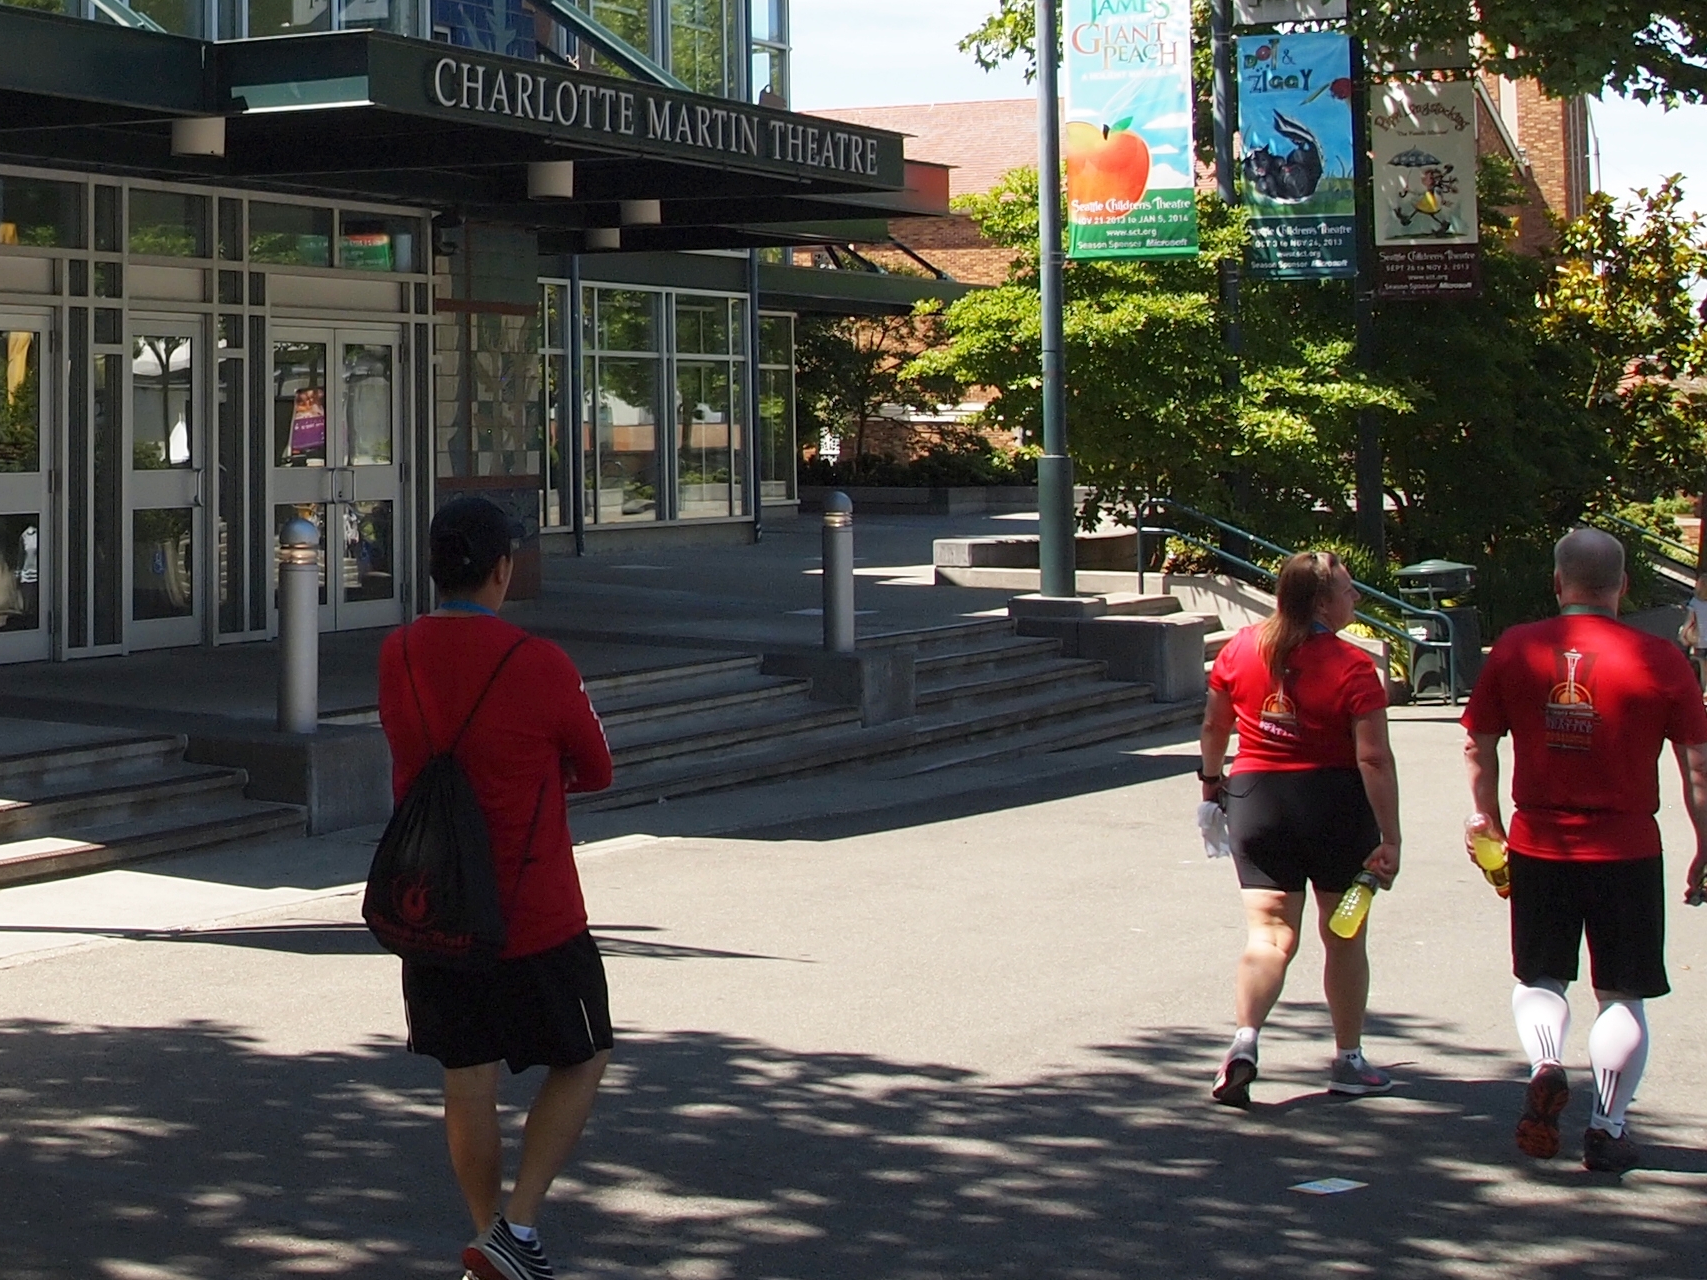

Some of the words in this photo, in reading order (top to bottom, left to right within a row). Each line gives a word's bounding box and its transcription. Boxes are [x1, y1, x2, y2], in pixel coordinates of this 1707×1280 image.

[1071, 22, 1166, 54] GIANT
[1103, 42, 1177, 70] PEACH
[434, 58, 635, 135] CHARLOTTE
[647, 97, 759, 156] MARTIN
[770, 120, 878, 175] THEATRE
[1071, 199, 1103, 213] Seattle
[1152, 196, 1191, 209] Theatre
[1106, 228, 1156, 236] www.sct.org
[1317, 222, 1352, 235] Theatre
[1077, 241, 1107, 249] Season
[1109, 241, 1142, 249] Sponsor
[1146, 239, 1187, 247] Microsoft
[1255, 240, 1271, 248] OCT
